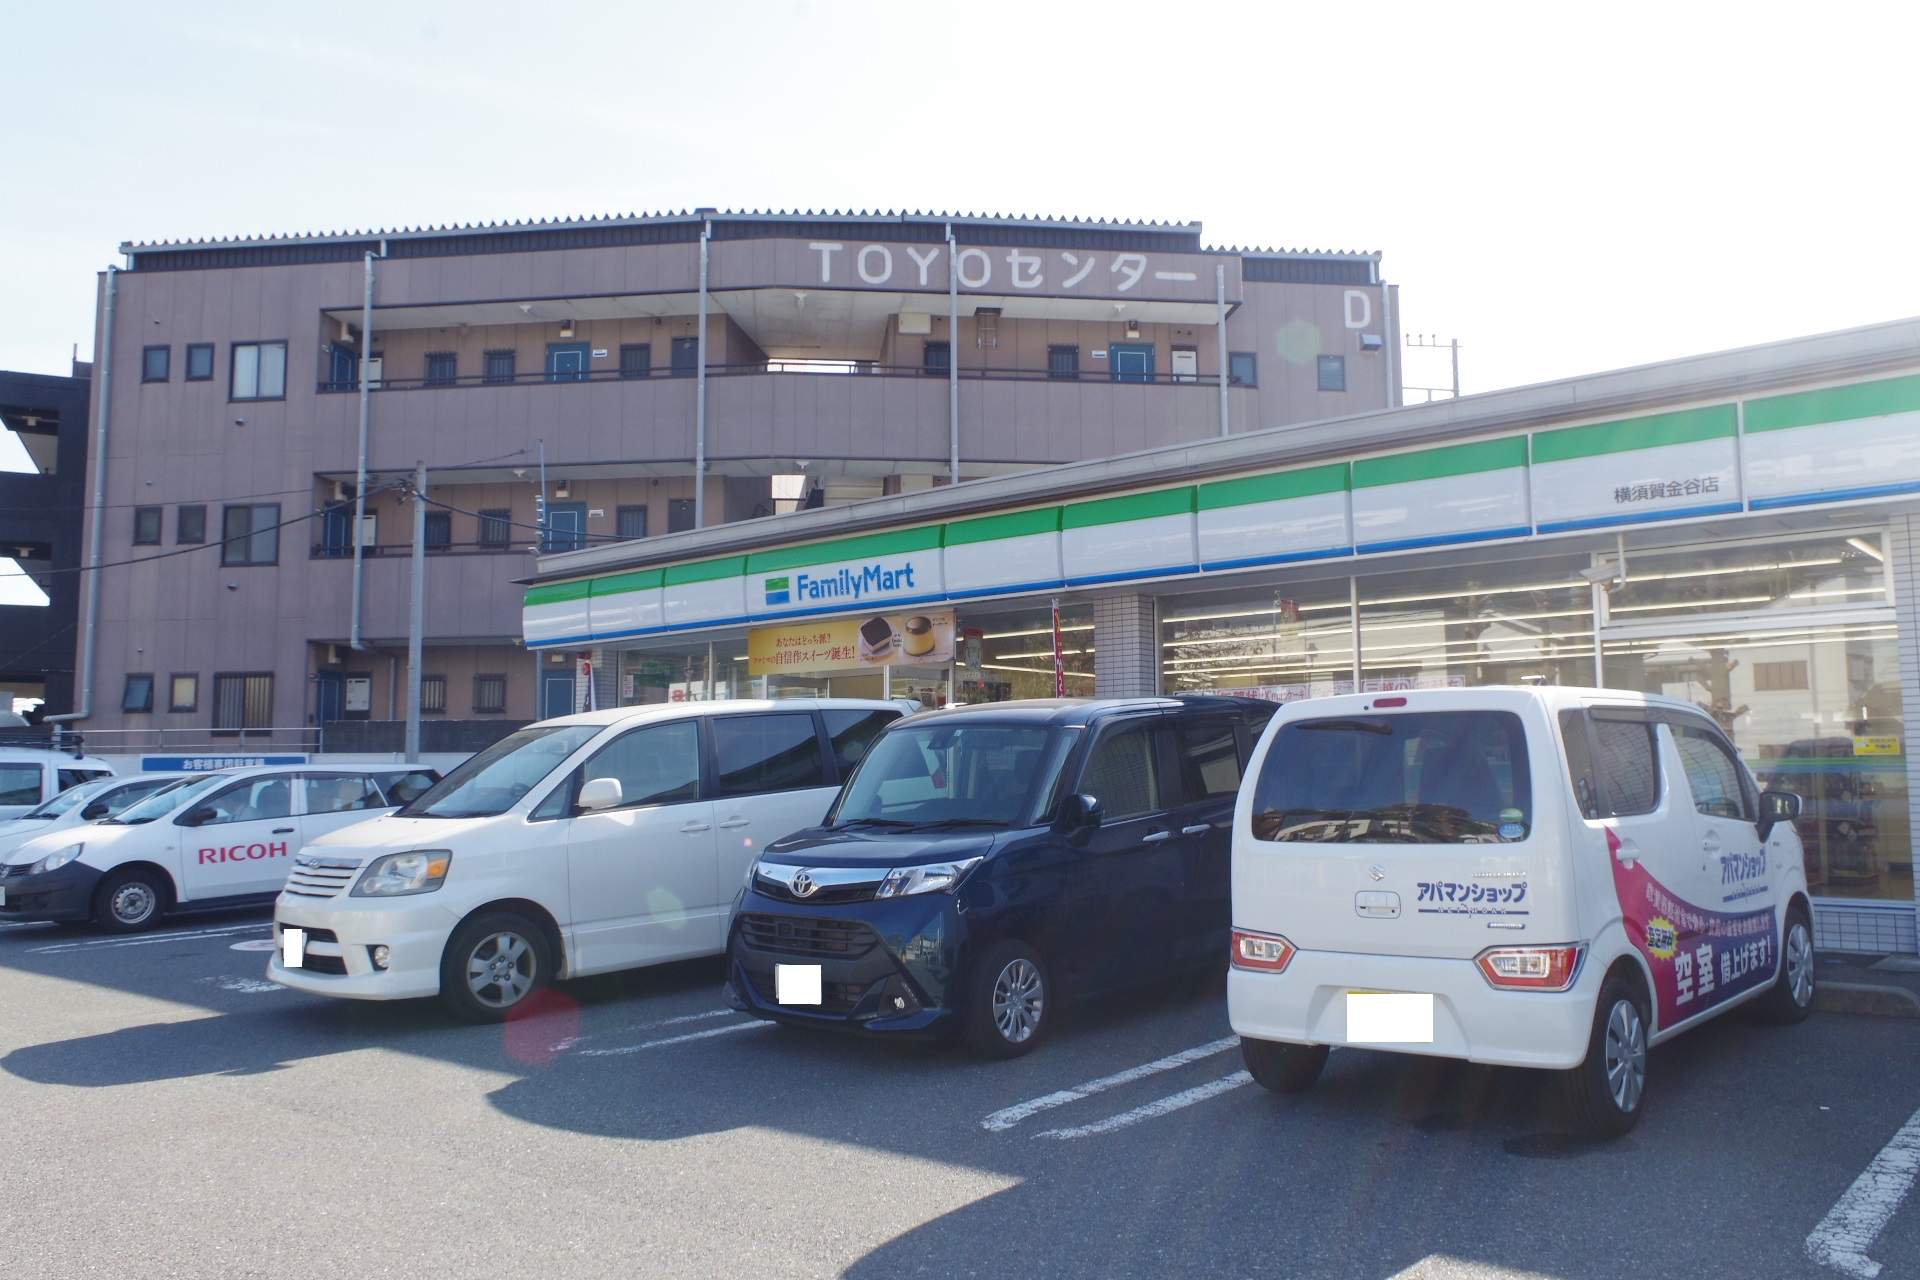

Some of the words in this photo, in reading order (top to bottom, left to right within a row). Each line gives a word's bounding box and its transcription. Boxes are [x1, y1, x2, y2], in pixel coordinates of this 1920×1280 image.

[1343, 289, 1371, 329] D
[1615, 476, 1720, 504] 横須賀金谷店
[798, 564, 914, 601] FamilyMart
[199, 842, 288, 865] RICOH
[1720, 848, 1766, 885] アパマンショップ
[1416, 881, 1528, 903] アパマンショップ
[1674, 943, 1716, 1006] 空室
